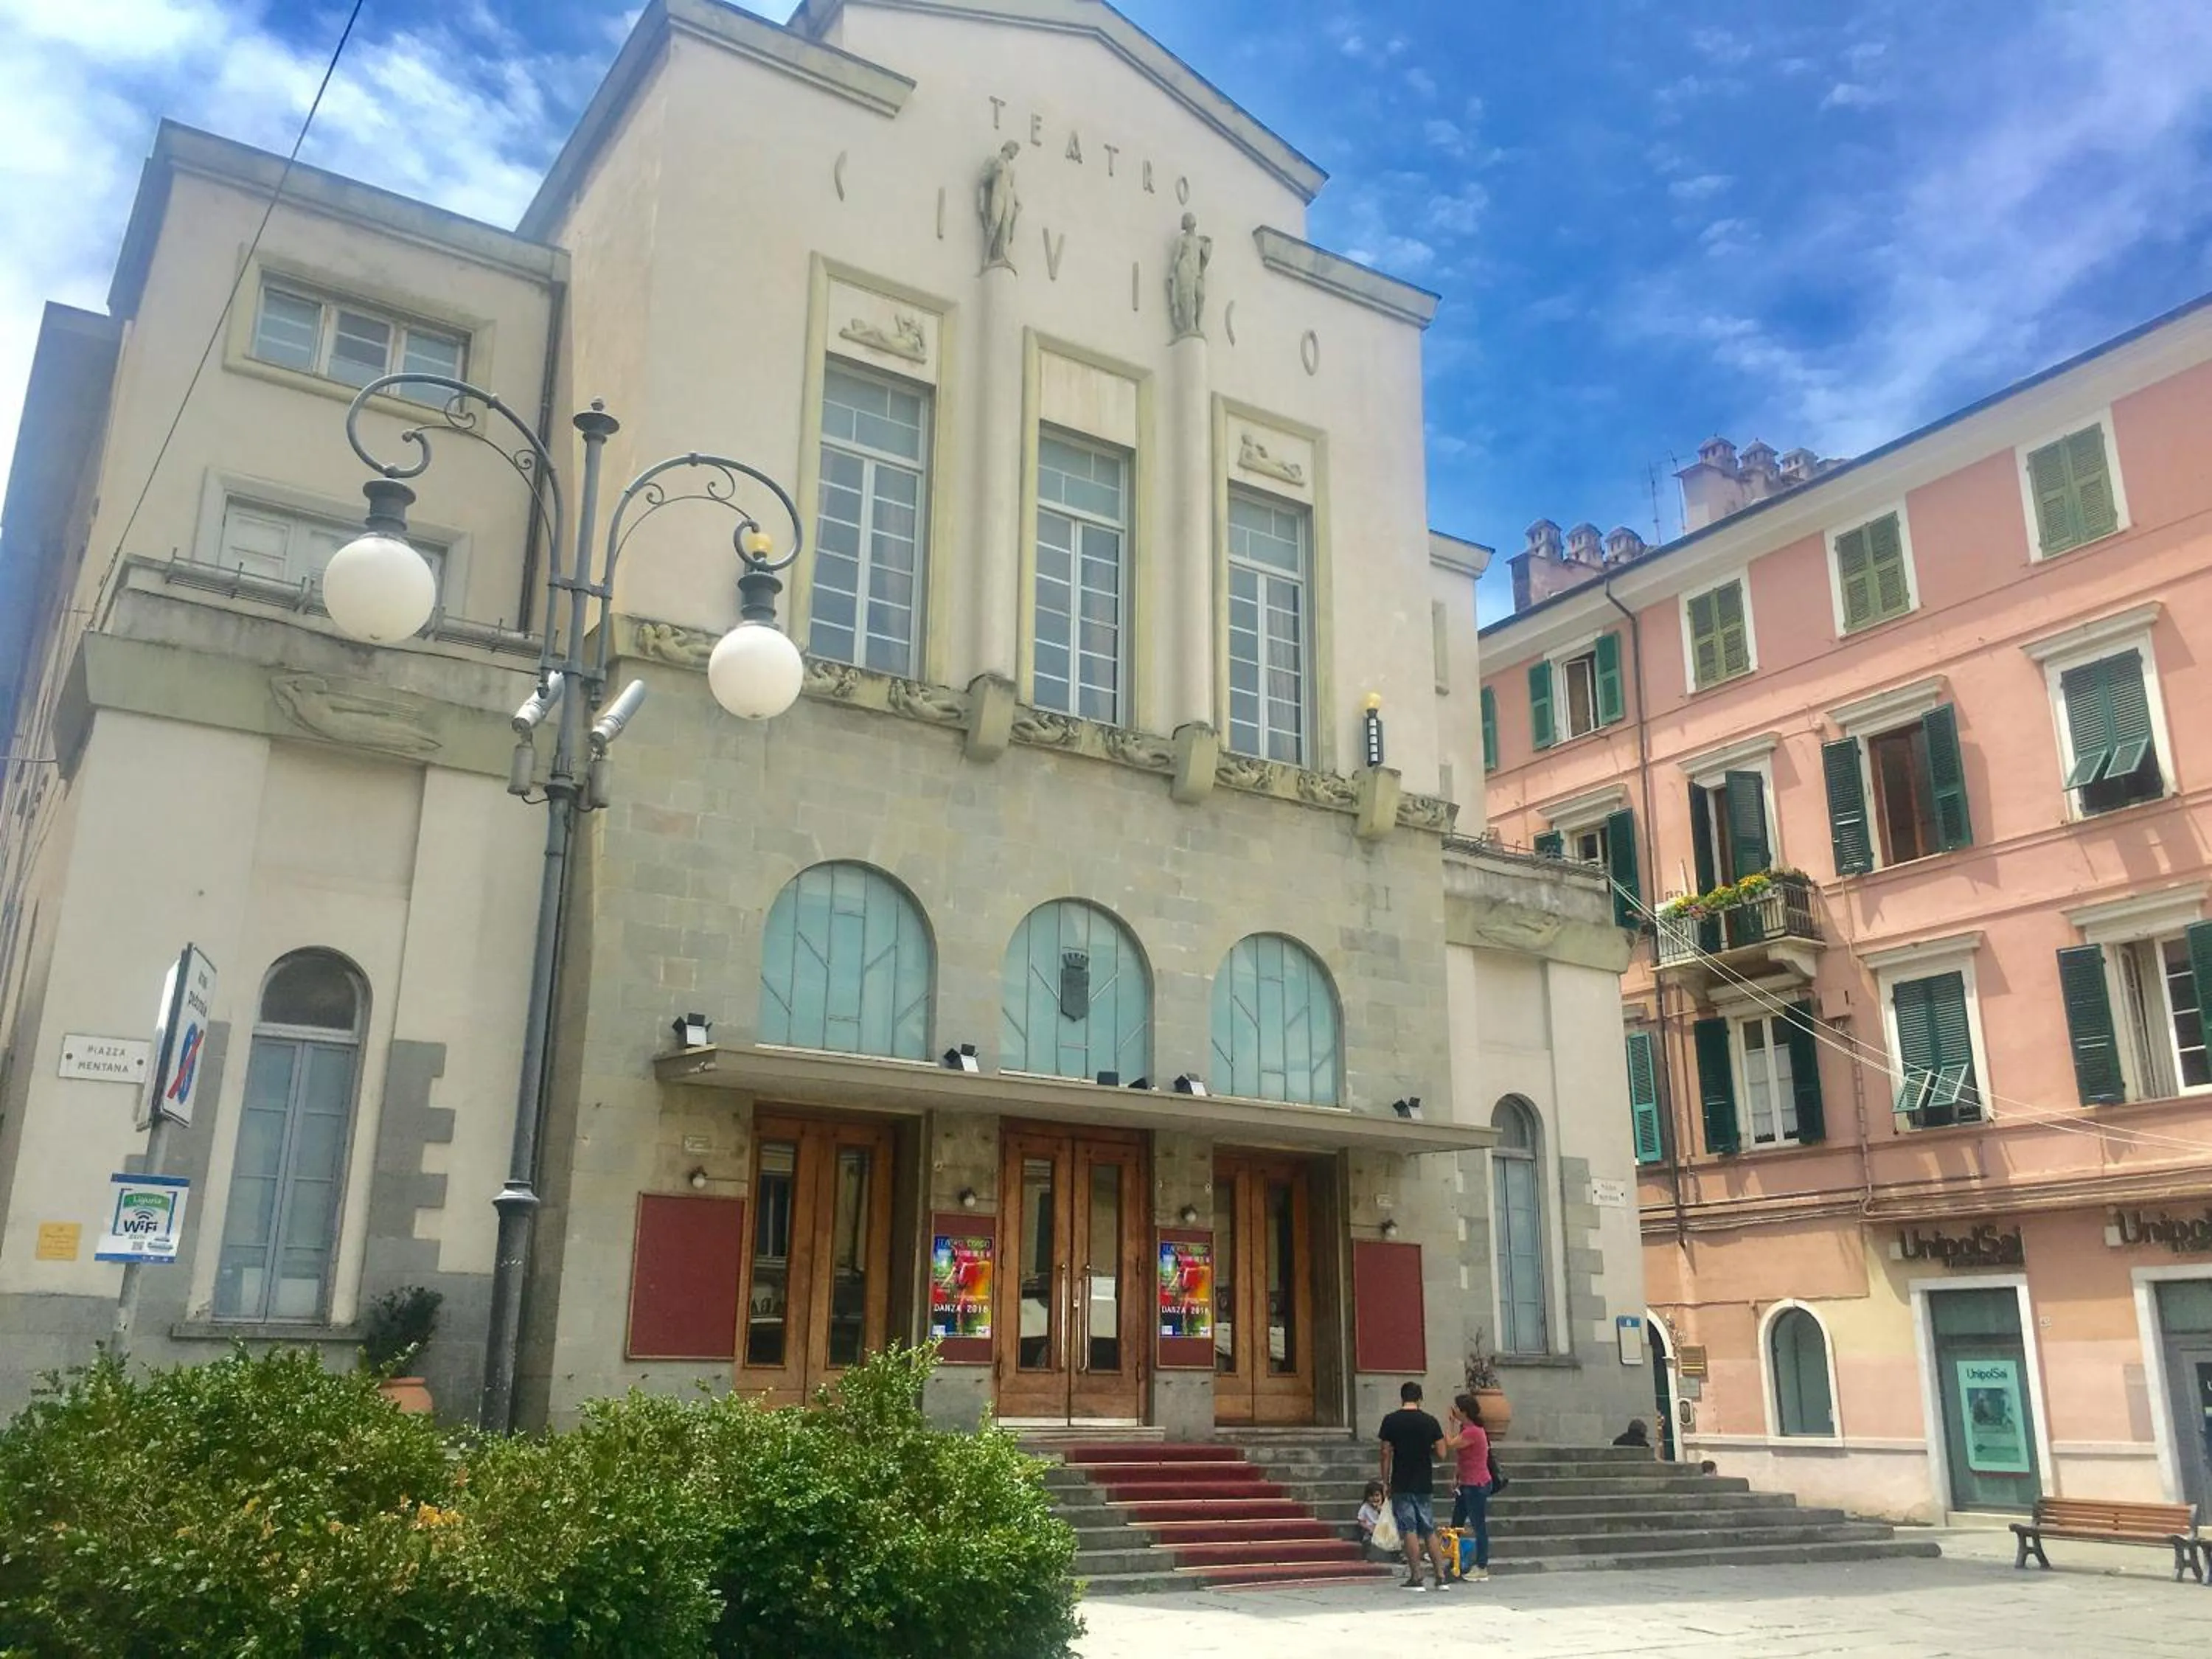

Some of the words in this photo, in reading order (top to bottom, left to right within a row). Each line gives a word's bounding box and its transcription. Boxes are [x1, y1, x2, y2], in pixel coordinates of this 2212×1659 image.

[989, 96, 1190, 206] TEATRO
[834, 151, 1319, 375] CIVICO
[77, 1062, 128, 1073] MENTANA
[124, 1220, 158, 1233] WiFi
[933, 1303, 961, 1312] DANZA
[1161, 1305, 1186, 1314] DANZA
